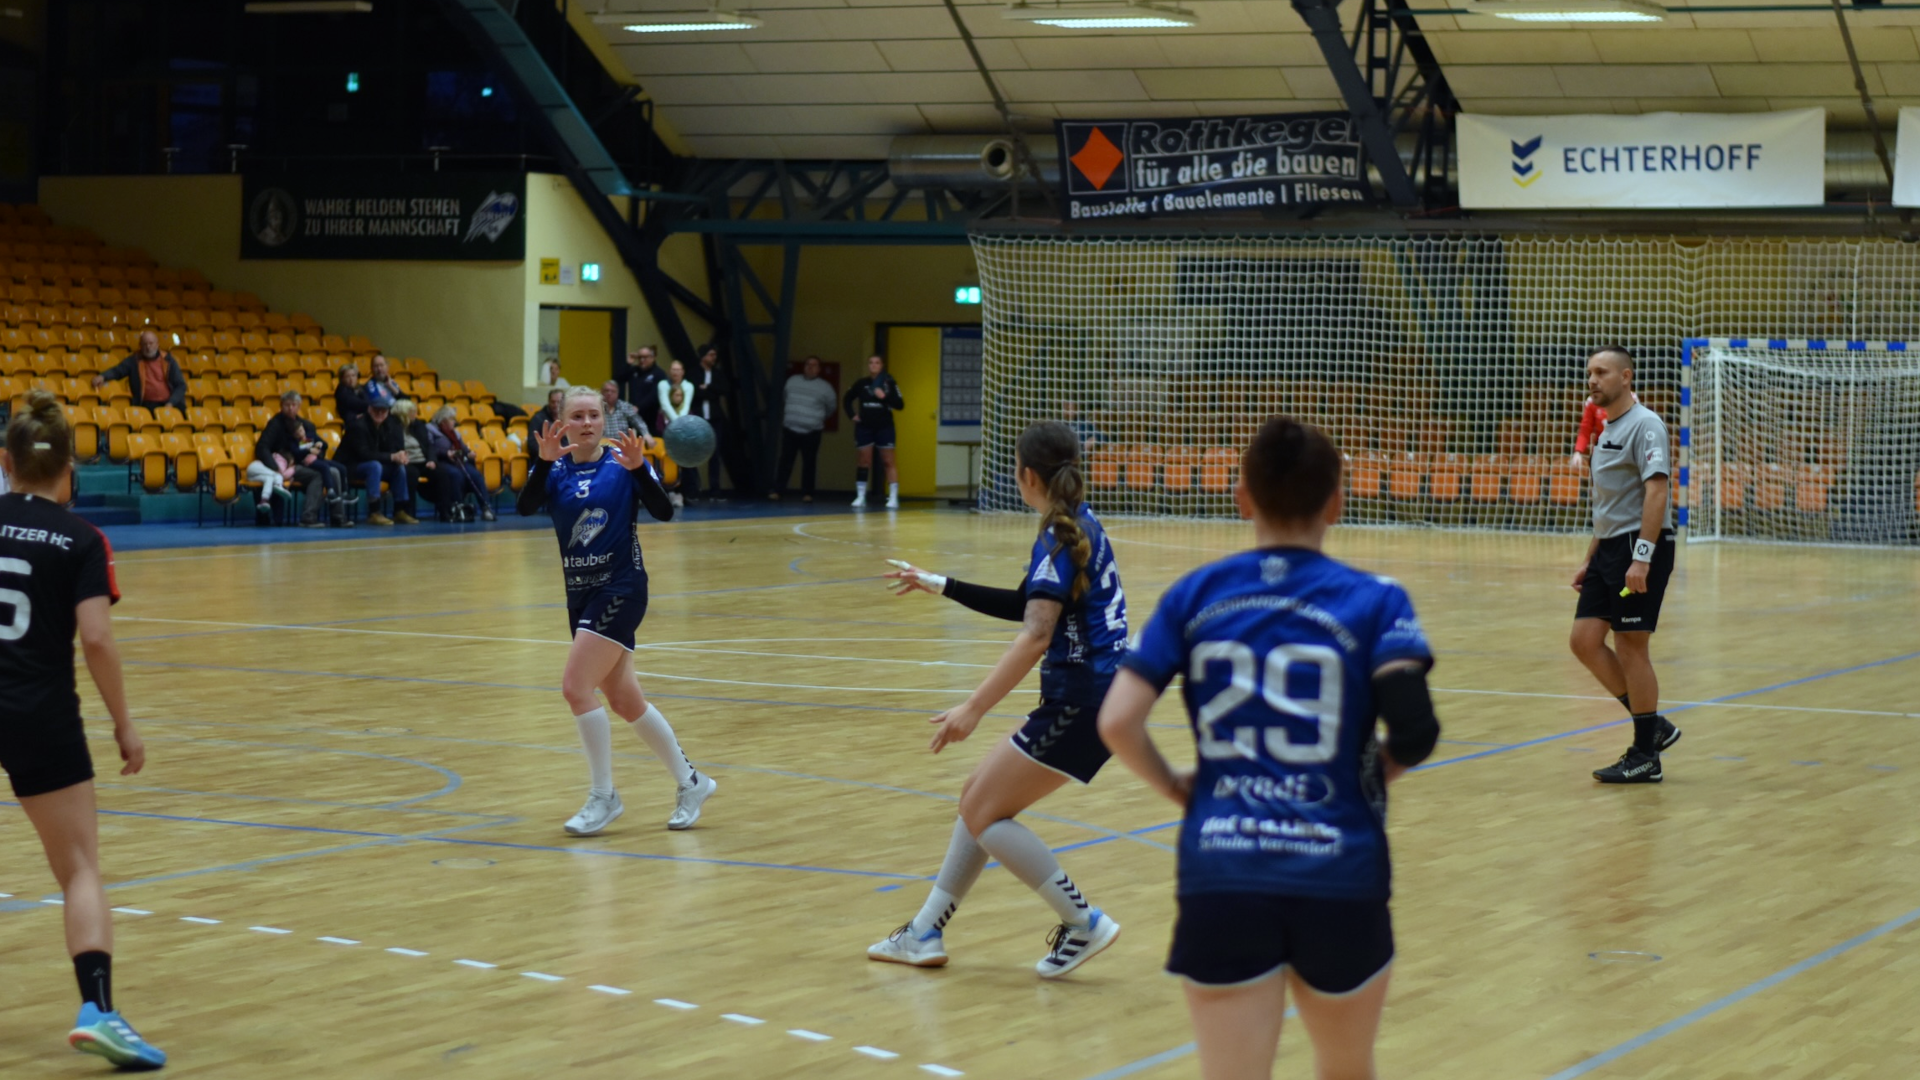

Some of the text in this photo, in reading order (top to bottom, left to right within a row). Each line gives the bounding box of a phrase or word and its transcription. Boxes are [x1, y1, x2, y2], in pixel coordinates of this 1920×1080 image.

[1136, 145, 1356, 188] für alle die bauen
[1563, 143, 1762, 174] ECHTERHOFF
[304, 198, 460, 217] WAHRE HELDEN STEHEN
[1163, 188, 1276, 211] Bauelemente
[1294, 182, 1363, 203] Fliesen
[304, 217, 460, 236] ZU IHRER MANNSCHAFT
[574, 478, 592, 499] 3
[0, 524, 73, 550] ITZER HC
[570, 552, 614, 568] tauber
[1189, 640, 1342, 764] 29
[1621, 761, 1654, 779] Kempa
